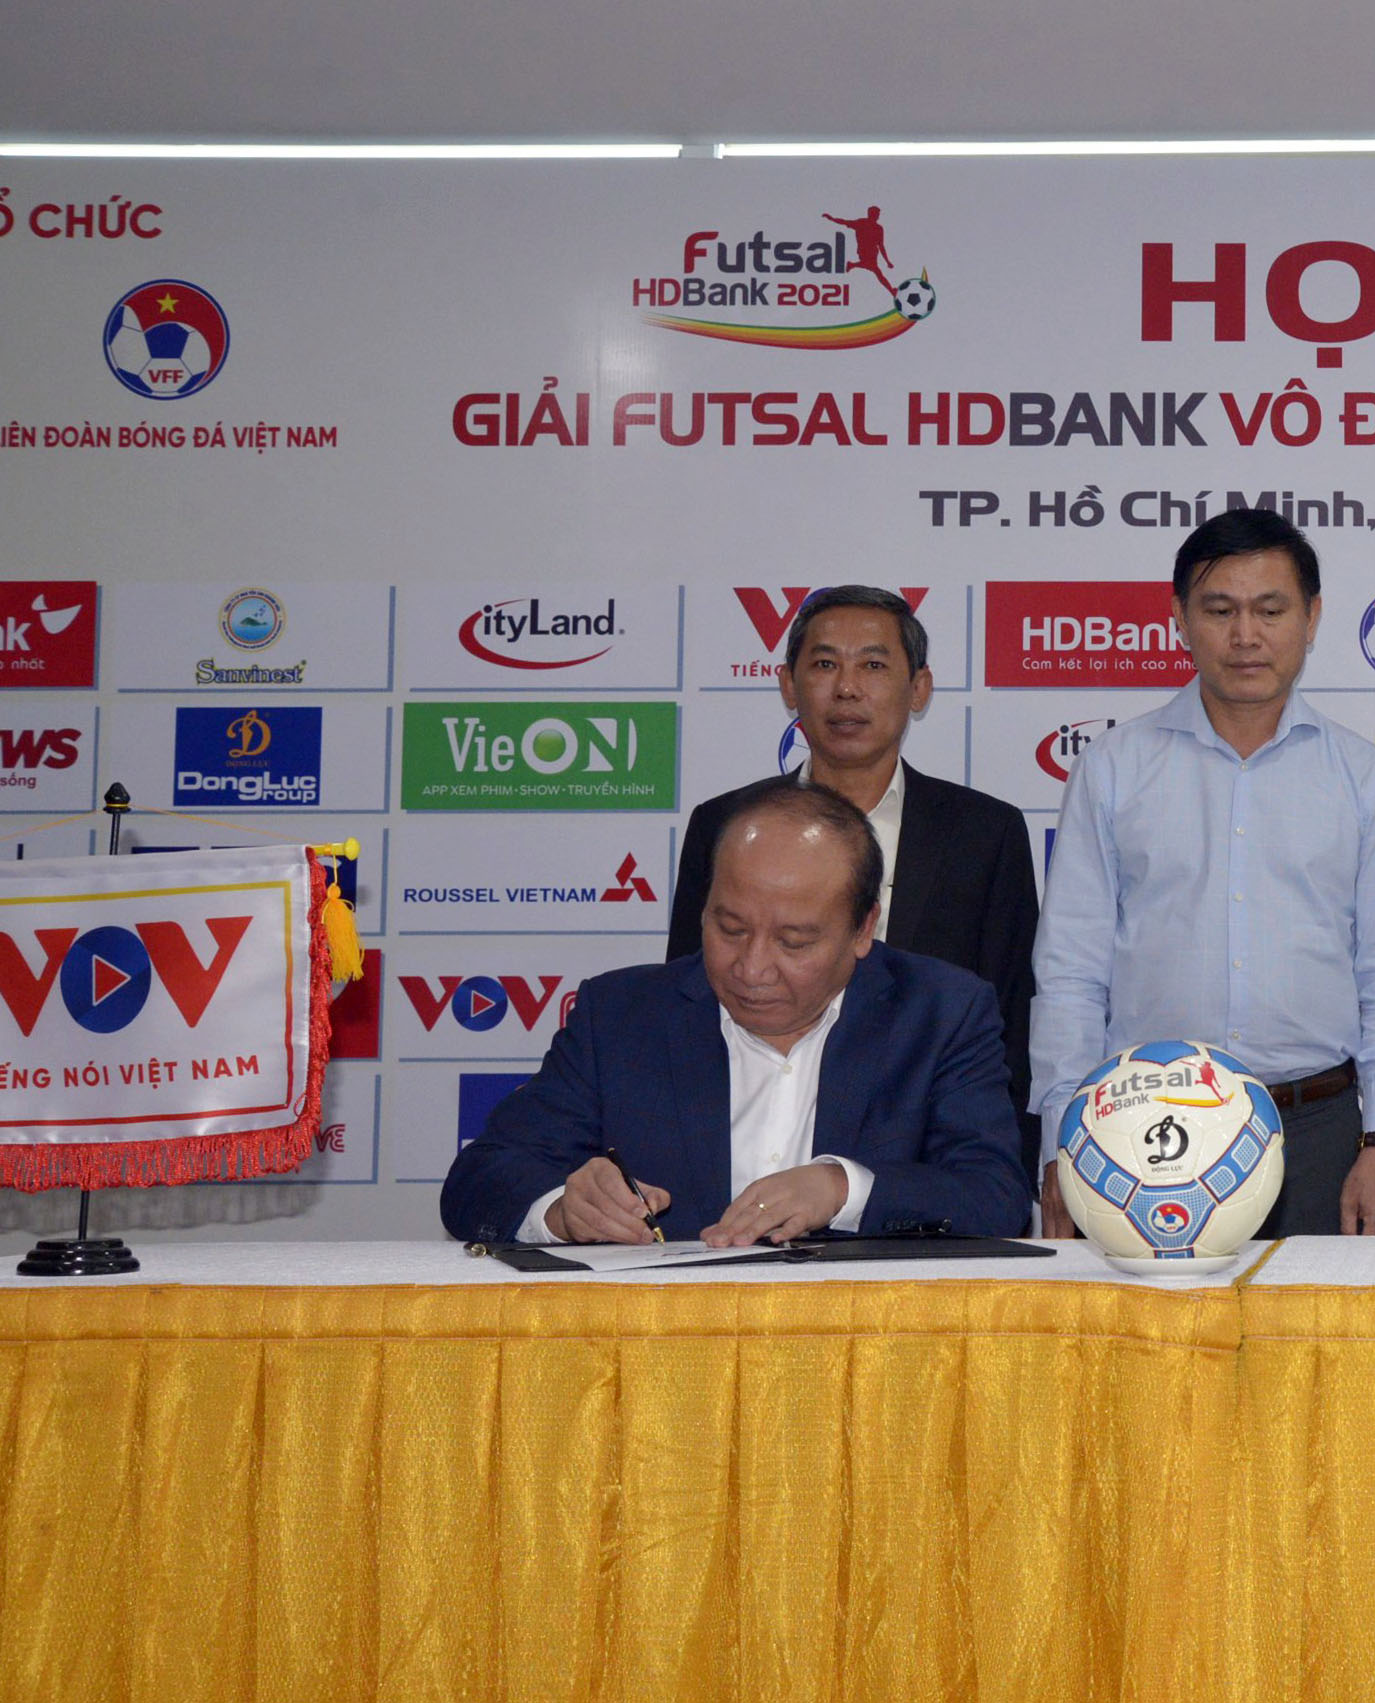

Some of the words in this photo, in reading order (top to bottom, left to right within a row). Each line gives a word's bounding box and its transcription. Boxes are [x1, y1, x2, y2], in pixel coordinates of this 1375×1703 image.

[29, 195, 163, 239] CHỨC
[684, 230, 846, 274] Futsal
[632, 277, 769, 307] HDBank
[777, 283, 850, 307] 2021
[148, 369, 184, 384] VFF
[452, 377, 590, 447] GIẢI
[612, 391, 888, 447] FUTSAL
[907, 391, 1208, 448] HDBANK
[1219, 378, 1322, 447] VÔ
[43, 420, 111, 448] ĐOÀN
[118, 421, 186, 448] BÓNG
[193, 421, 226, 448] ĐÁ
[233, 421, 280, 455] VIỆT
[287, 426, 337, 448] NAM
[919, 491, 1011, 527] TP.
[1029, 485, 1106, 528] Hồ
[1120, 491, 1213, 528] Chí
[1022, 616, 1191, 651] HDBank
[196, 658, 304, 685] Sanvinest
[1022, 657, 1052, 670] Cam
[1141, 660, 1167, 670] cao
[422, 785, 448, 796] APP
[451, 785, 477, 796] XEM
[481, 785, 513, 796] PHIM
[519, 784, 559, 796] SHOW
[622, 783, 655, 796] HÌNH
[403, 888, 498, 903] ROUSSEL
[507, 888, 596, 903] VIETNAM
[398, 976, 563, 1032] VOV
[64, 1061, 109, 1087] NÓI
[119, 1058, 177, 1089] VIỆT
[191, 1055, 260, 1080] NAM
[1095, 1068, 1193, 1107] Futsal
[1096, 1093, 1151, 1120] HDBank
